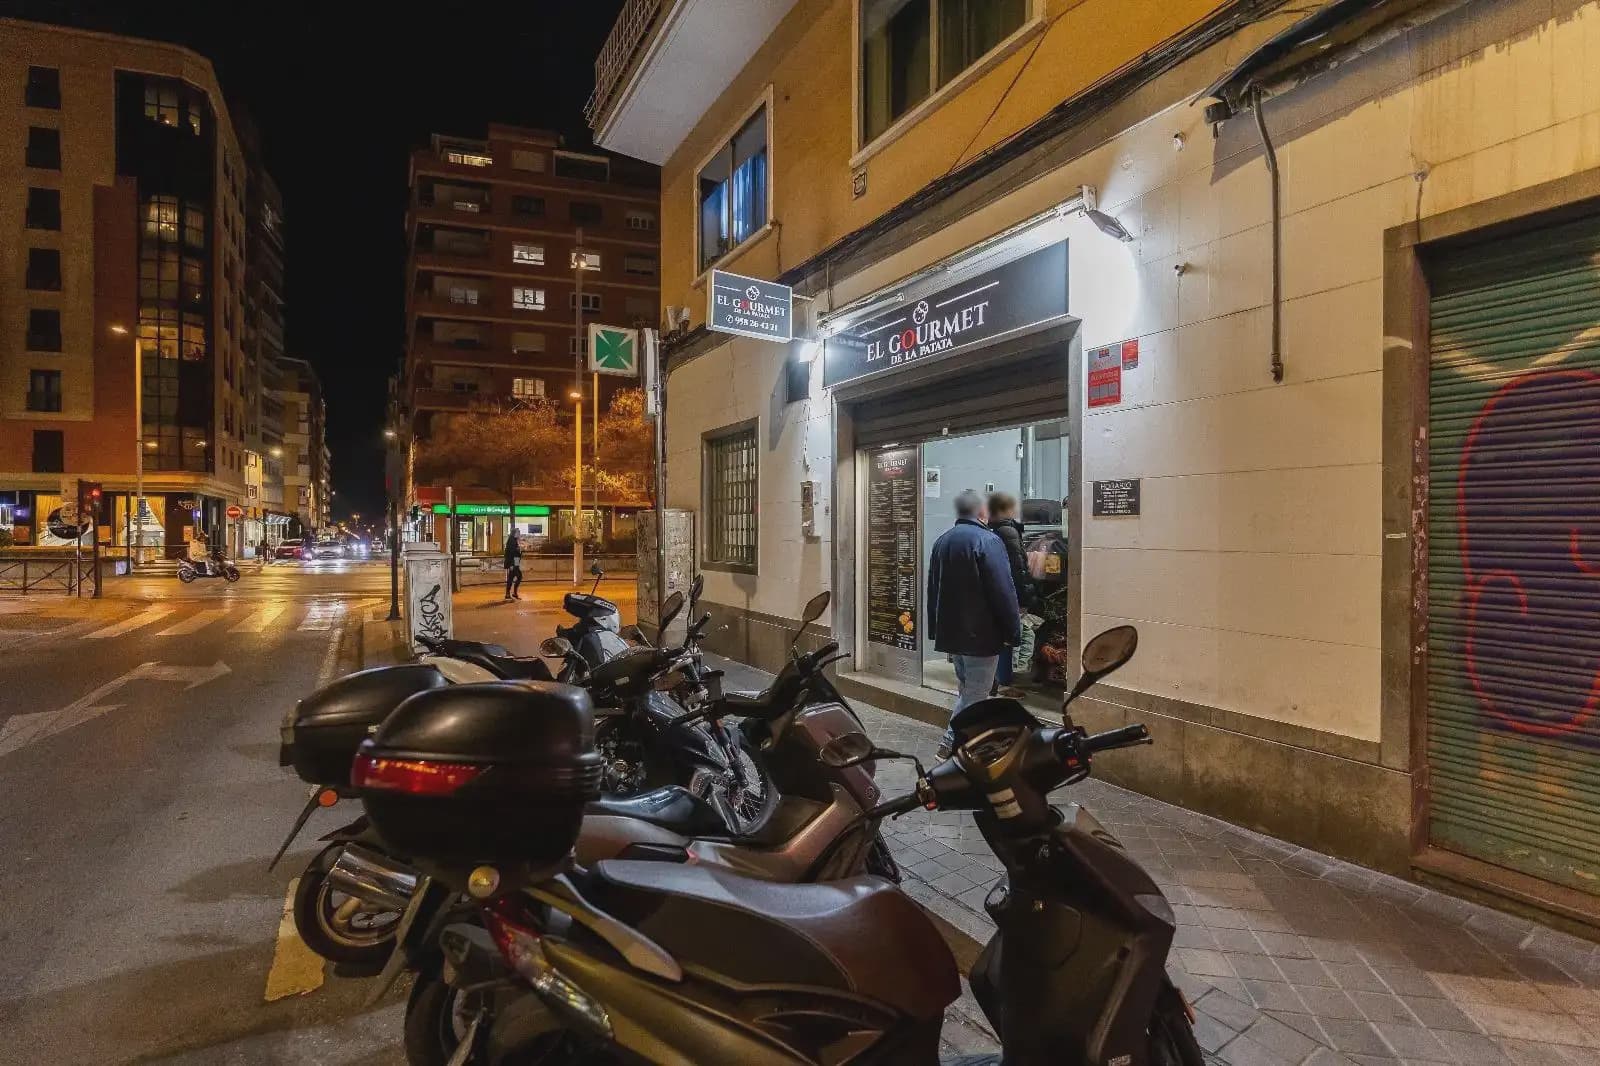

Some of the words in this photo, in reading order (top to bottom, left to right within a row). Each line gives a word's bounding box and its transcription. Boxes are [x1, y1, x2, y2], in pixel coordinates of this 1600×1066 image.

[717, 295, 730, 306] EL
[732, 298, 787, 317] GOURMET
[866, 341, 885, 363] EL
[888, 301, 989, 353] GOURMET
[891, 353, 903, 365] DE
[904, 349, 917, 361] LA
[919, 338, 954, 358] PATATA
